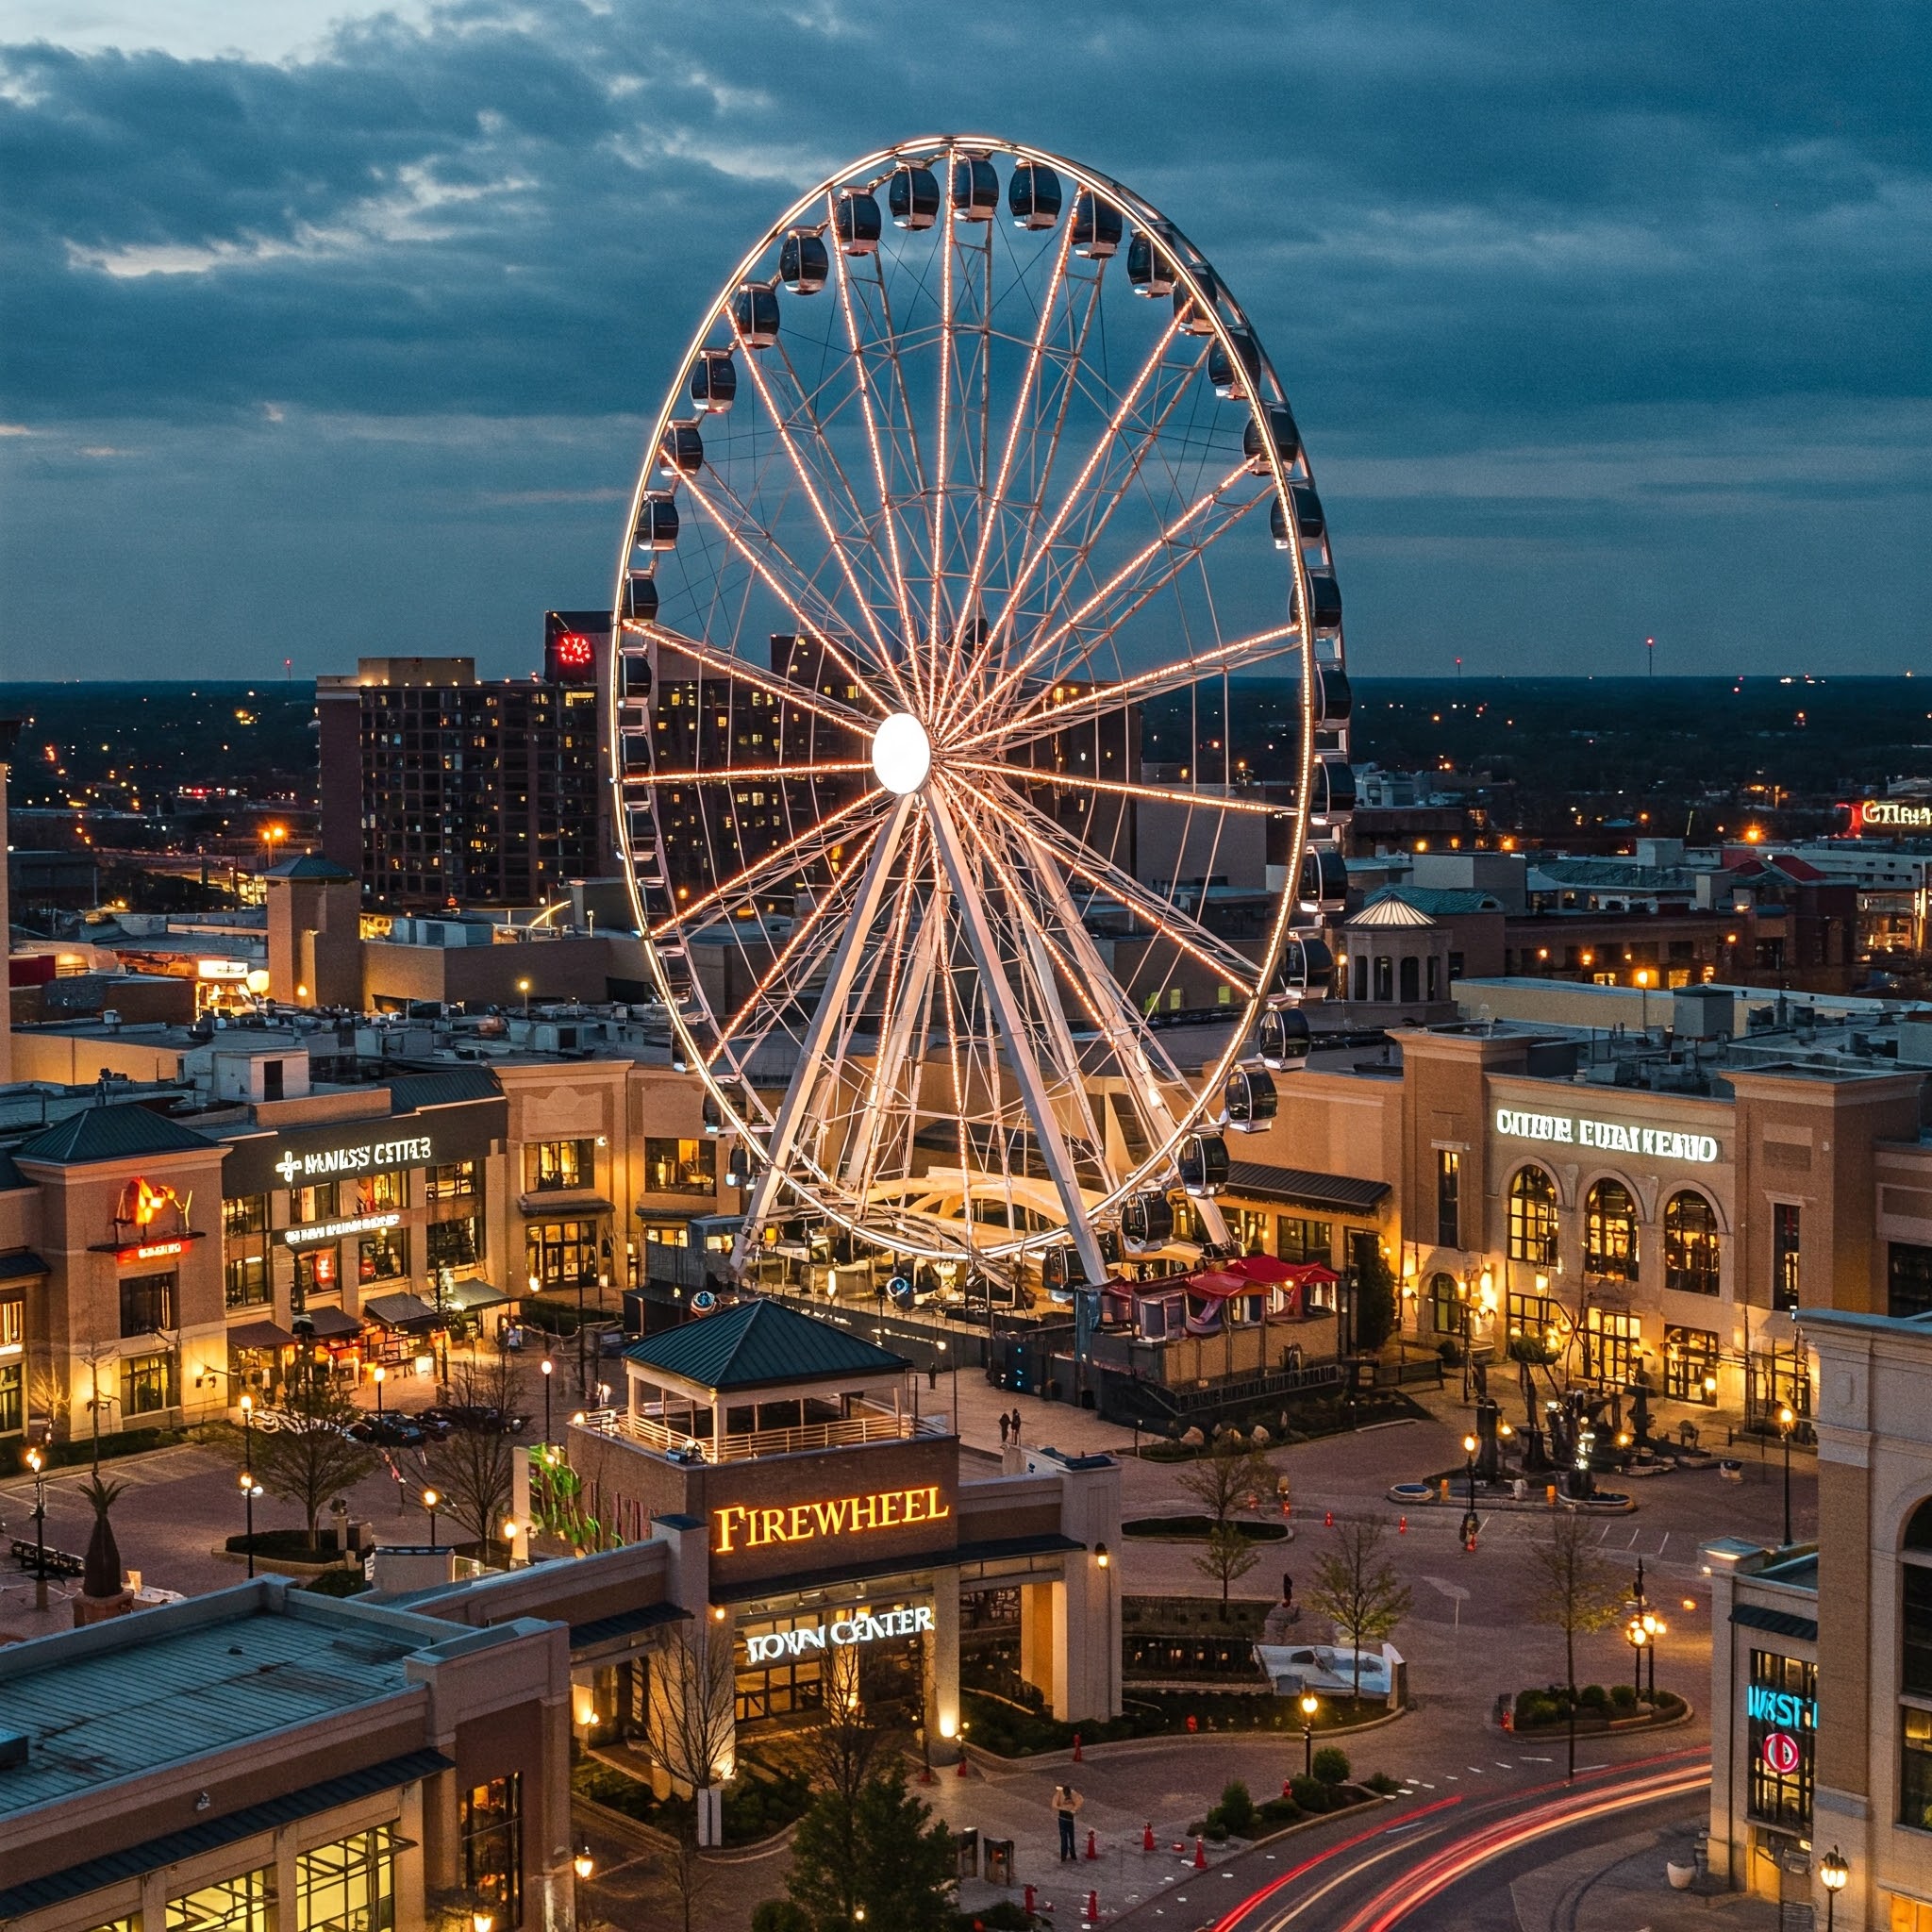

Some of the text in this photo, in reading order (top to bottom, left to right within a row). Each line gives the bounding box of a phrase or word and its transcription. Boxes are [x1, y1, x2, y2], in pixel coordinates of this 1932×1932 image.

[714, 1487, 949, 1553] FIREWHEEL
[746, 1607, 935, 1665] TOWN CENTER
